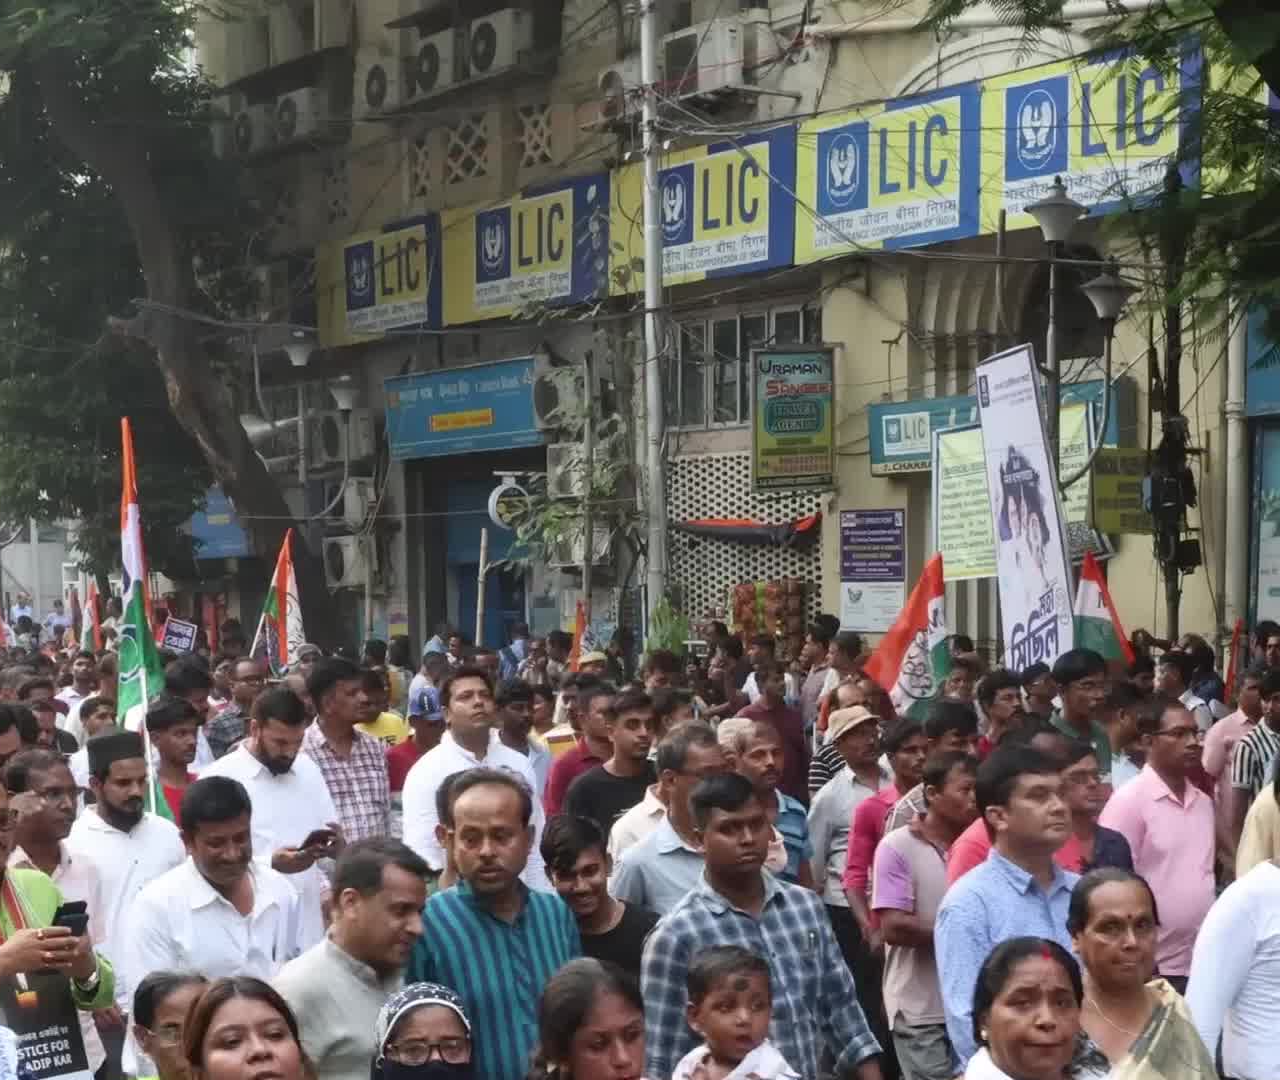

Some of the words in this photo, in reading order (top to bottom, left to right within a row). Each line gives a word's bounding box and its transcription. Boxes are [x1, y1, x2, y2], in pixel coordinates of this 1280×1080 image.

[1080, 67, 1165, 158] LIC
[879, 114, 949, 196] LIC
[702, 157, 760, 231] LIC
[517, 202, 565, 267] LIC
[380, 236, 421, 297] LIC
[759, 360, 823, 376] URAMAN
[903, 417, 928, 440] LIC
[50, 1039, 71, 1053] FOR
[53, 1052, 73, 1066] KAR
